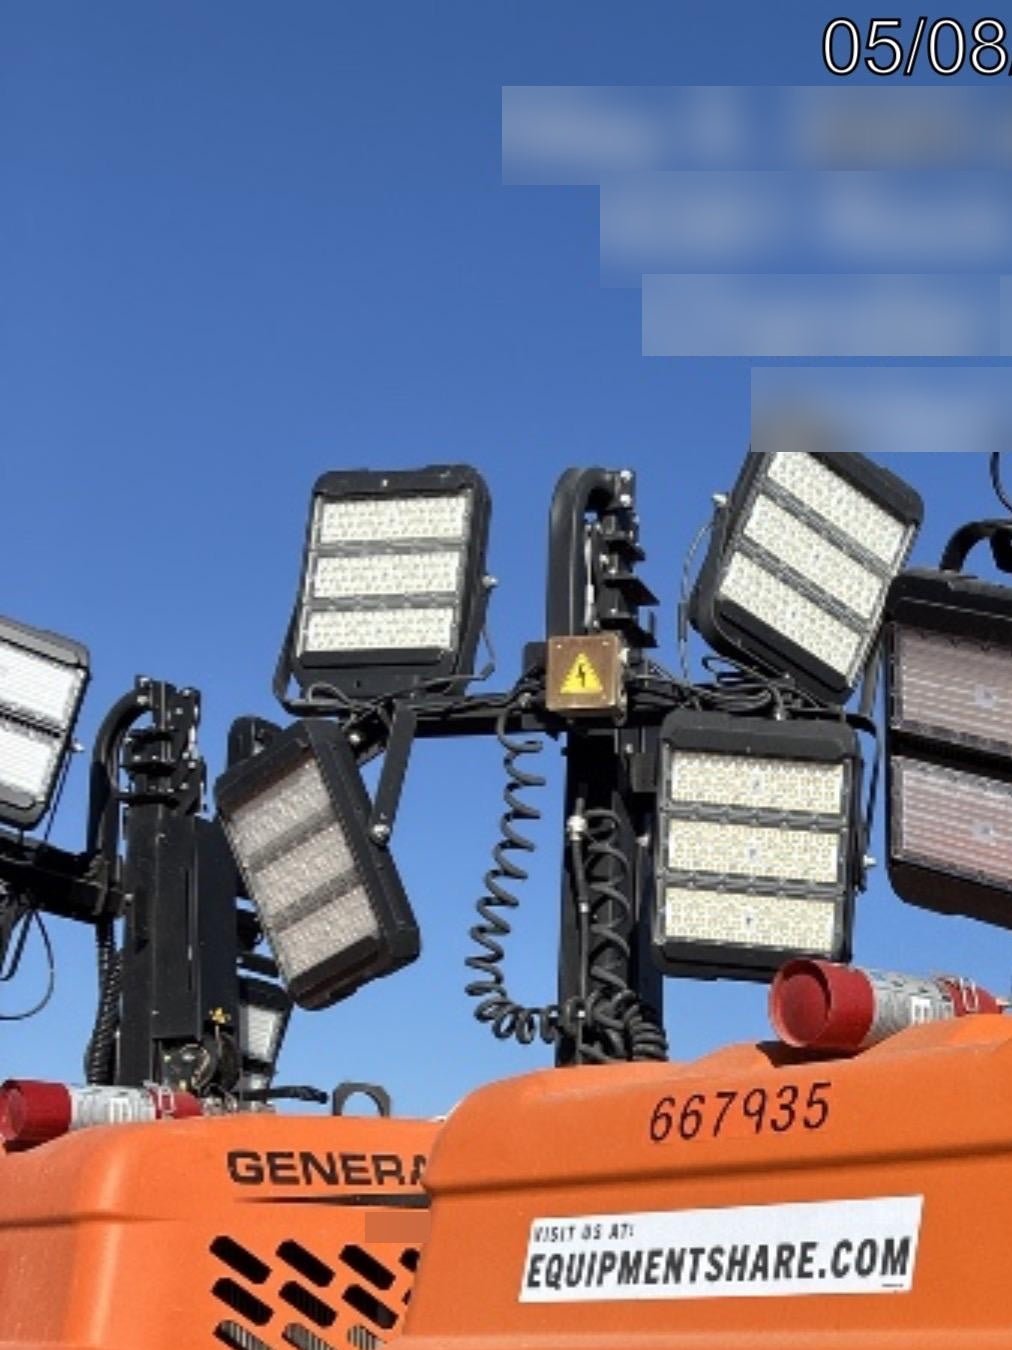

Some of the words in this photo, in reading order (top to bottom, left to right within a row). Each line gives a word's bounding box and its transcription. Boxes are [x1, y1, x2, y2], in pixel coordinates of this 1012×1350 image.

[650, 1082, 831, 1142] 667935
[534, 1225, 575, 1242] VISIT
[581, 1223, 601, 1240] US
[527, 1236, 911, 1290] EQUIPMENTSHARE.COM
